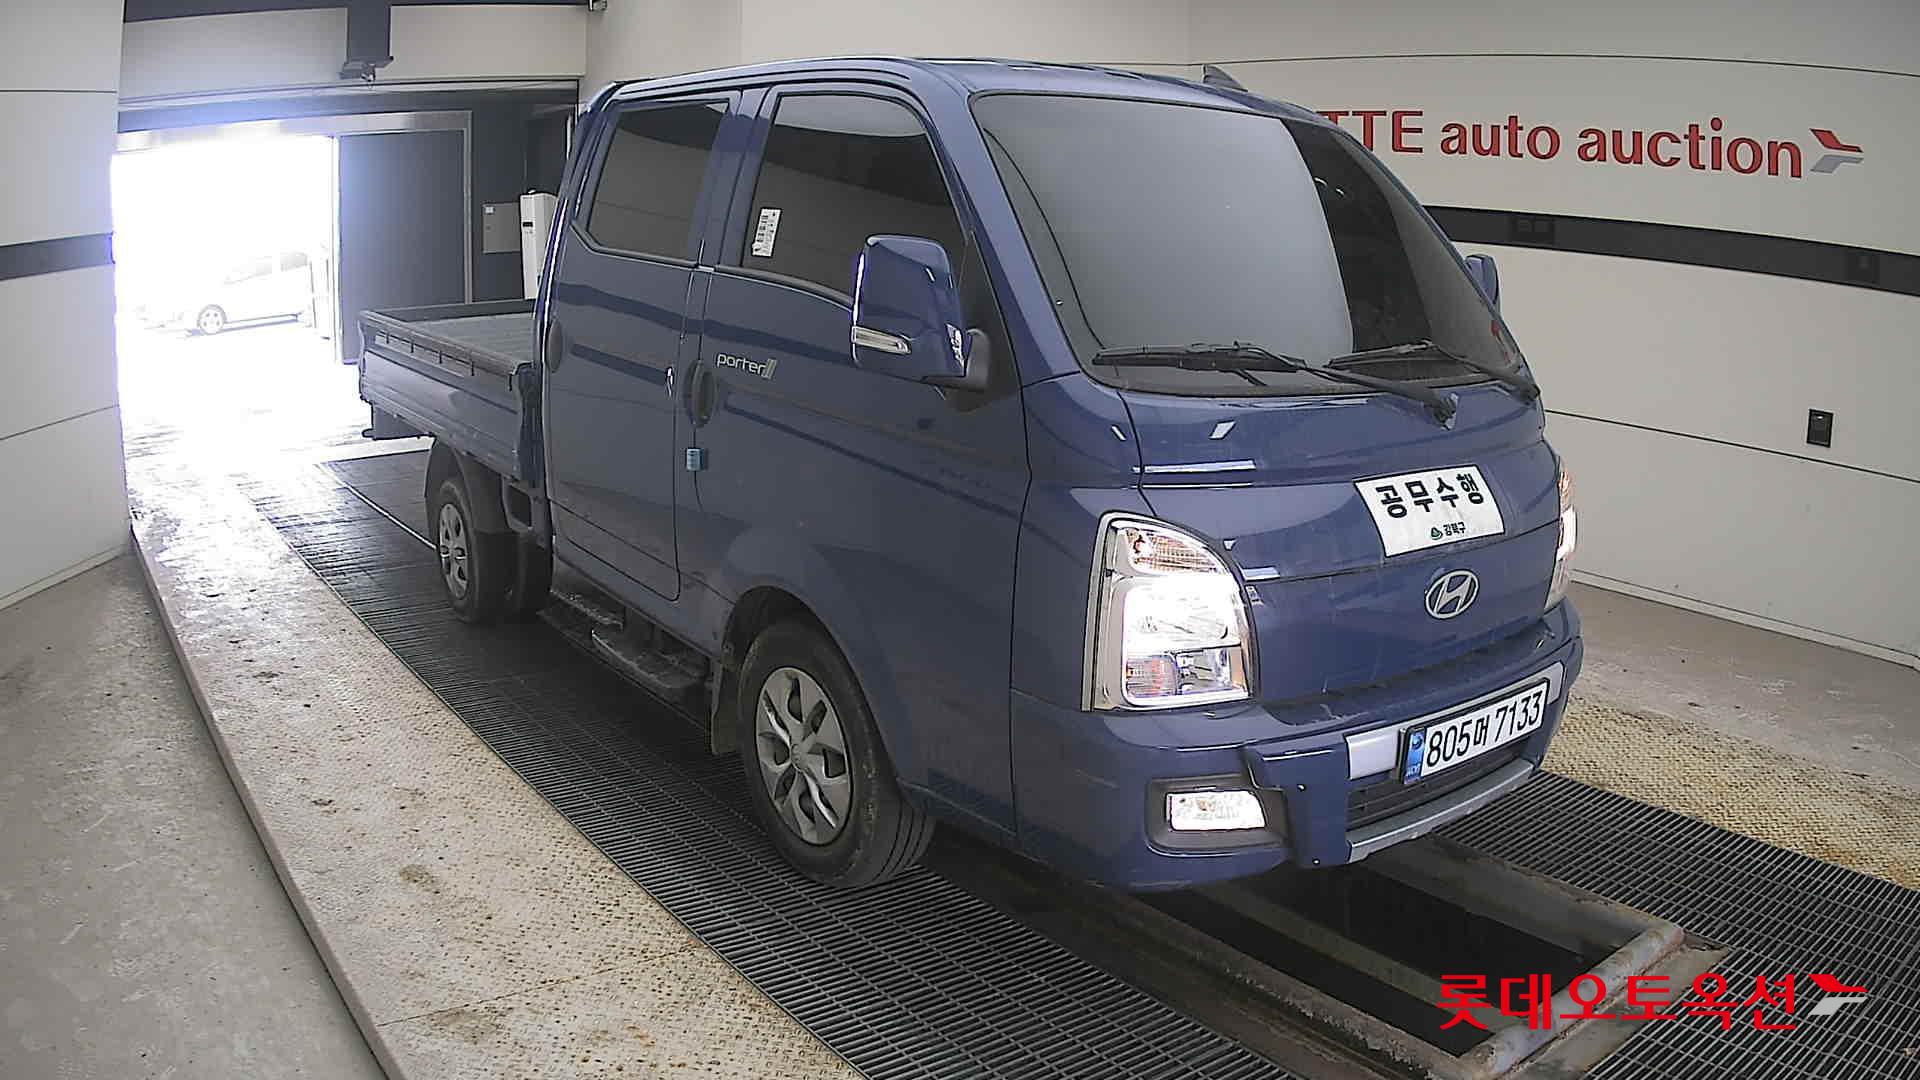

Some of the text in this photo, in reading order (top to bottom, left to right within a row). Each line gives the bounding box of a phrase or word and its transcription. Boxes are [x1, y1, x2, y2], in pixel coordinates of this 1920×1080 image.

[1439, 115, 1561, 159] auto
[1577, 117, 1803, 179] auction
[716, 353, 767, 375] porter
[1375, 473, 1484, 518] 공무수행
[1427, 690, 1543, 767] 805머 7133
